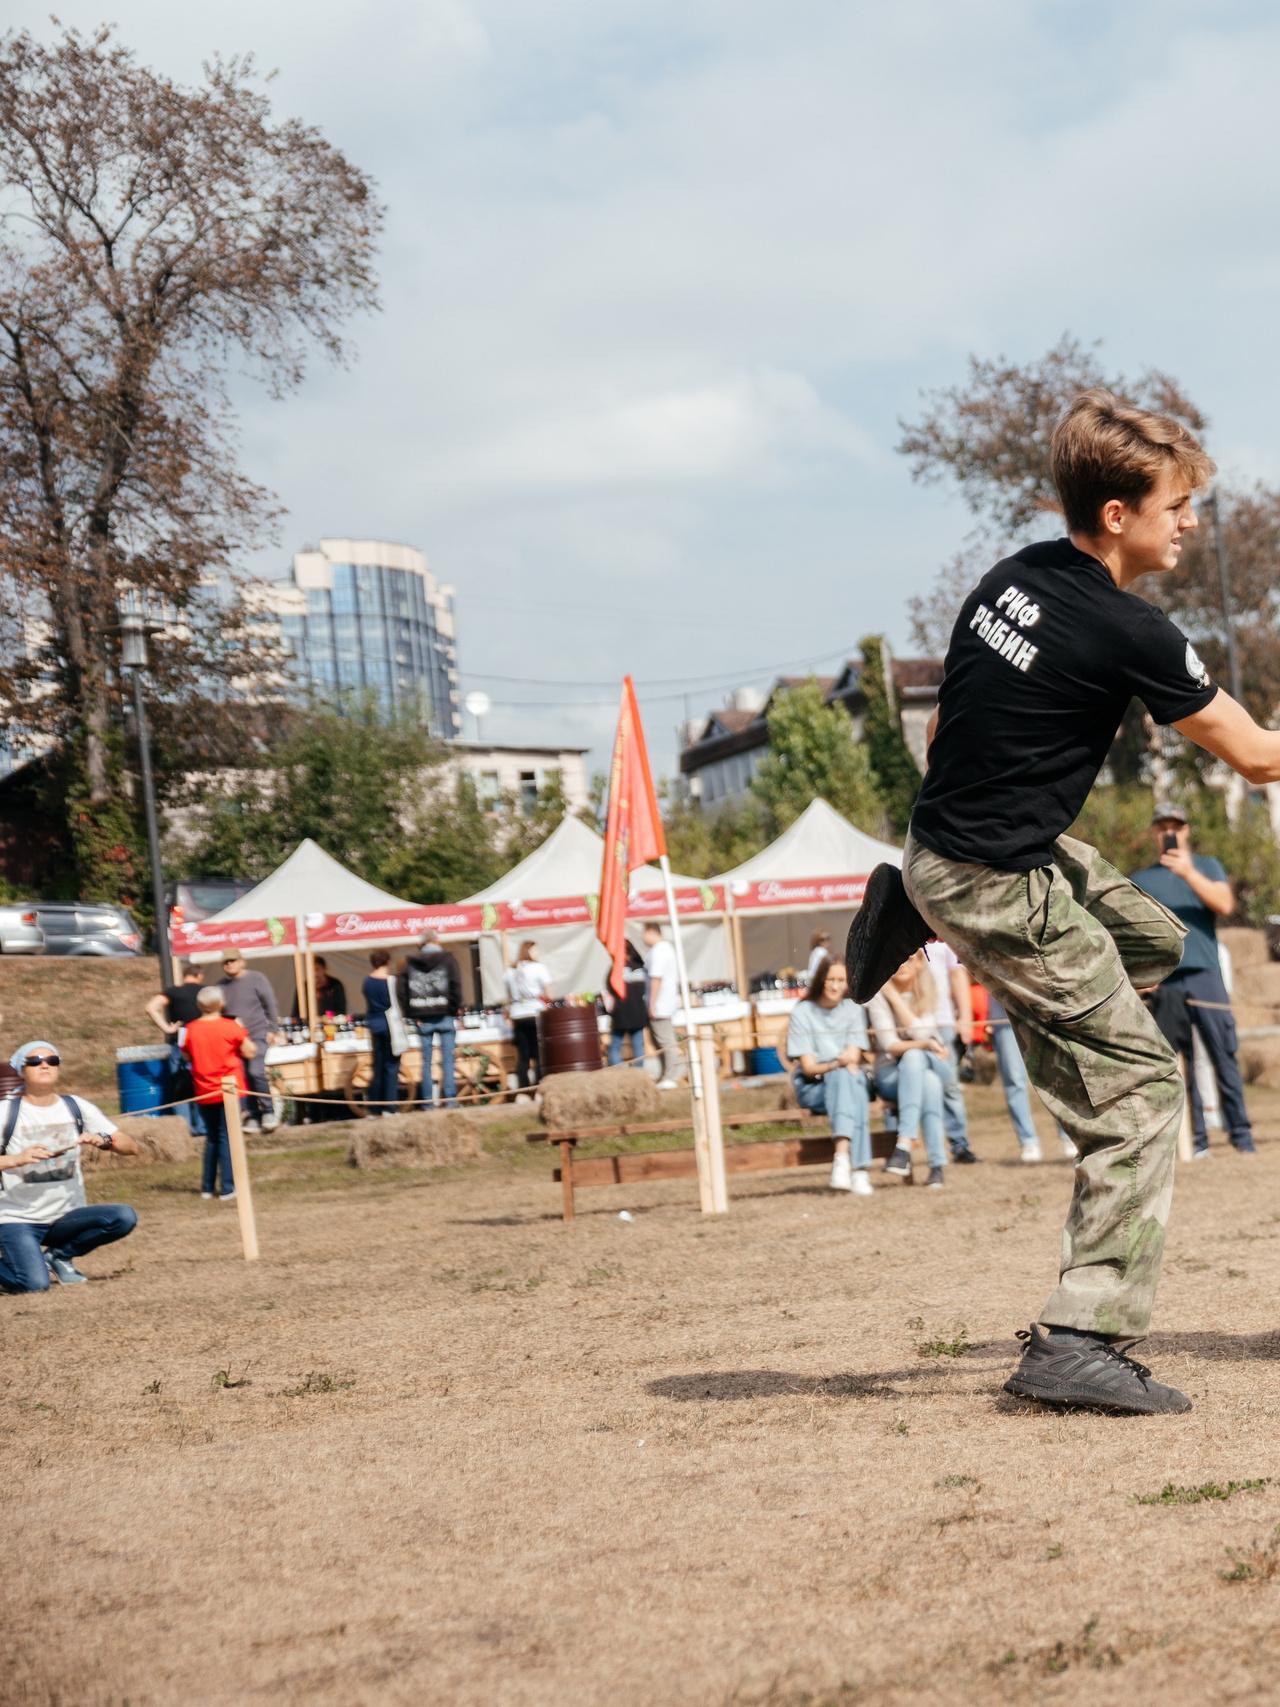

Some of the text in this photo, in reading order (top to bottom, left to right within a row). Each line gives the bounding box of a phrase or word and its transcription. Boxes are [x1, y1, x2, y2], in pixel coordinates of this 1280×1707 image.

[995, 585, 1040, 628] РИФ
[968, 604, 1039, 672] РЫБИН
[335, 913, 401, 936] Винная
